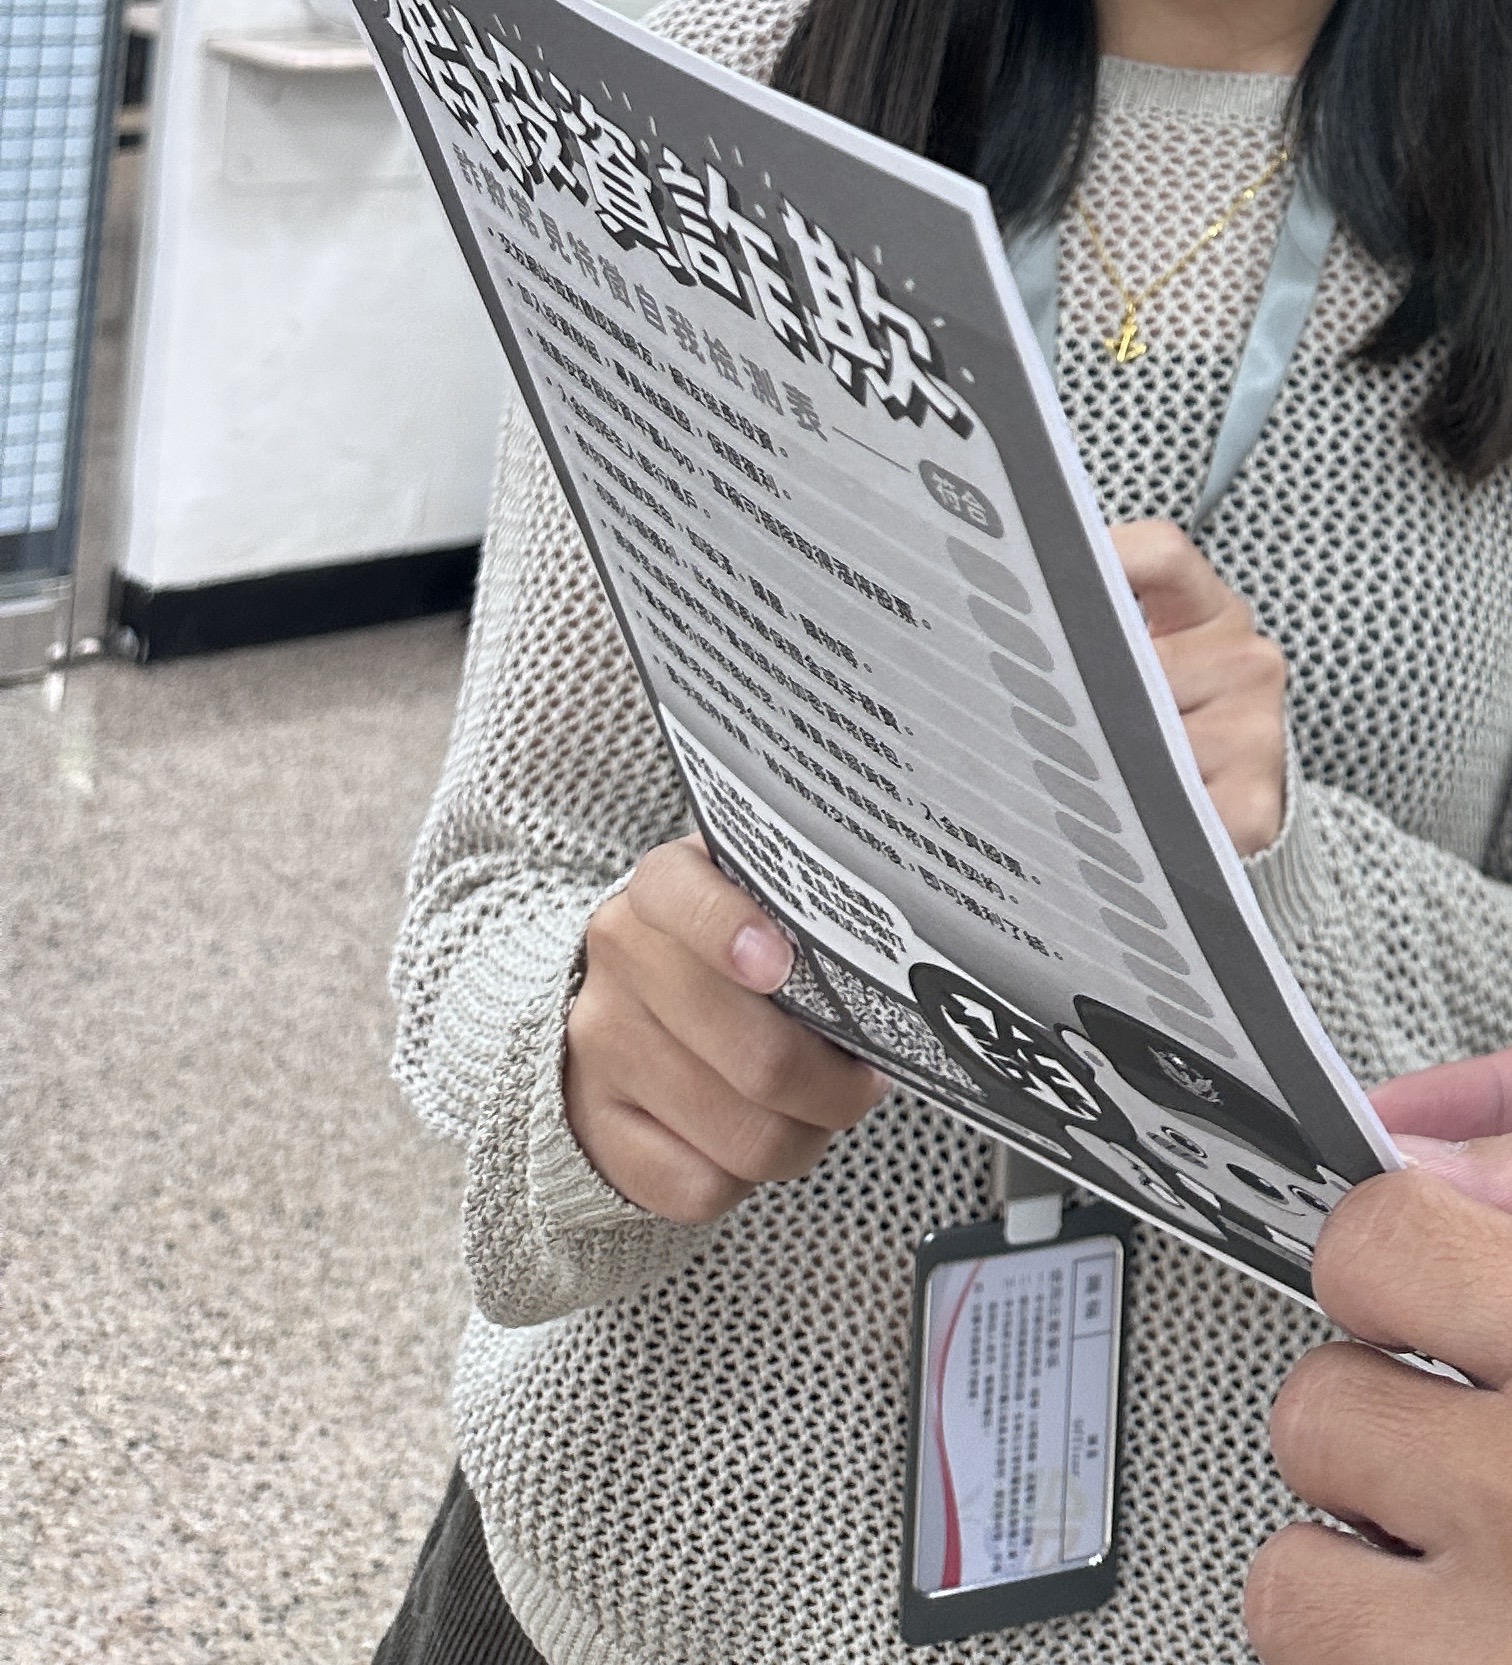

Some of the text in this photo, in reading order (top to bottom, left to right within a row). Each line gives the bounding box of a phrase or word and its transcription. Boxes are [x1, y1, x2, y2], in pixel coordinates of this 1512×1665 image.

[453, 143, 828, 441] 詐欺常見特徵自我檢測表
[931, 472, 988, 528] 符合
